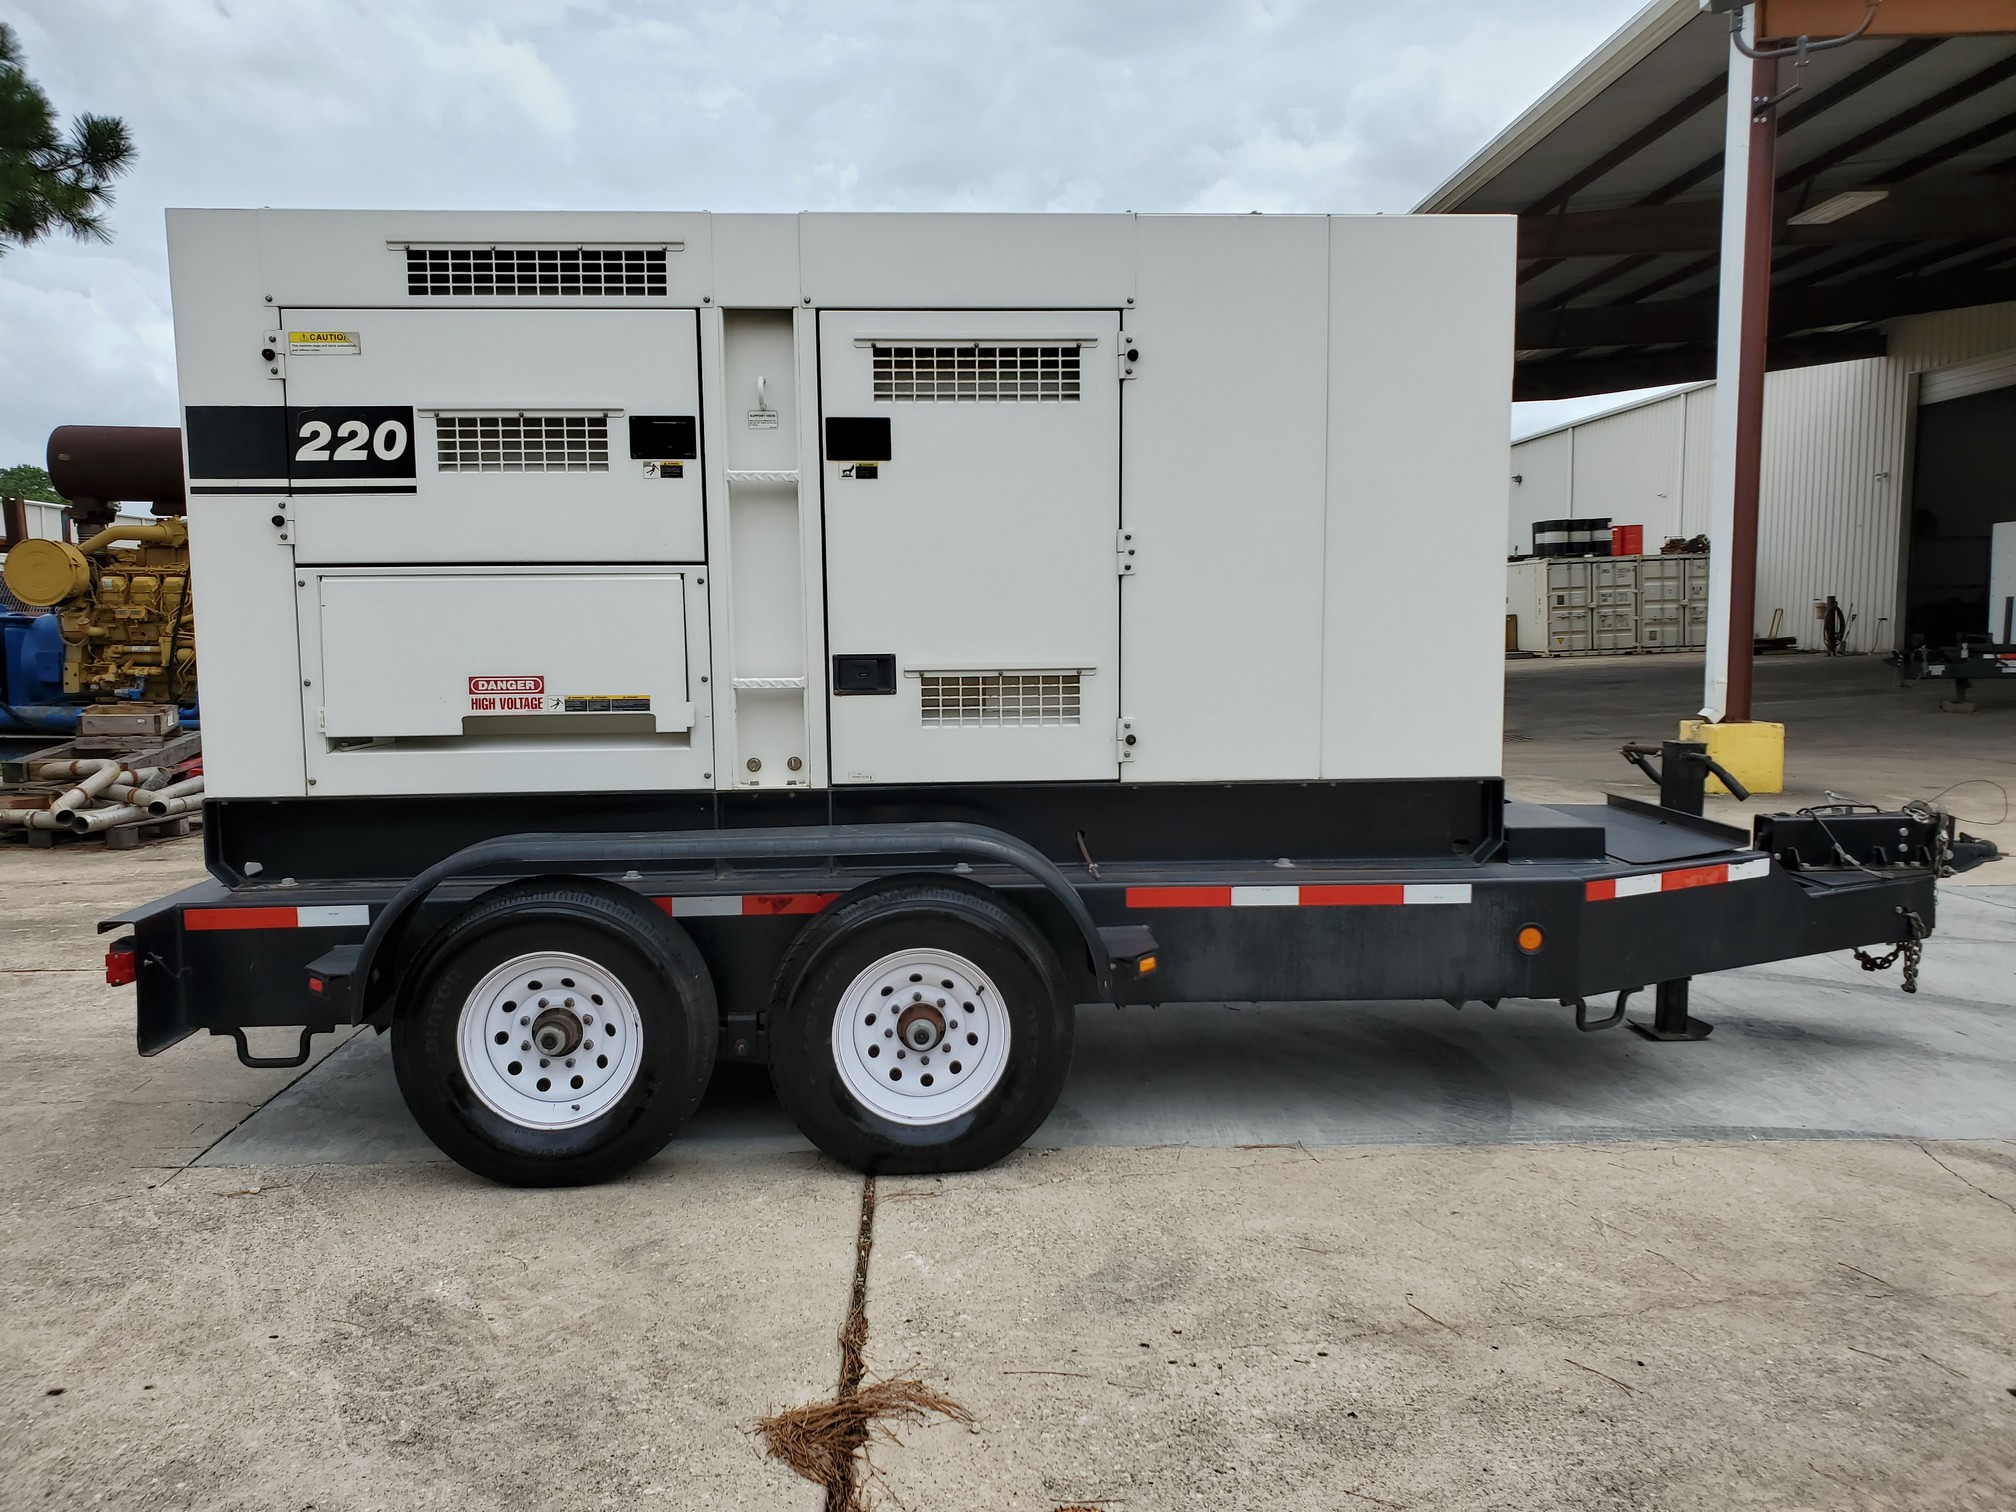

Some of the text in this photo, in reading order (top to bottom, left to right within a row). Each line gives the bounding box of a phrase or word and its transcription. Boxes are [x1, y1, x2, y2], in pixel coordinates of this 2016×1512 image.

[295, 420, 407, 461] 220
[478, 680, 535, 690] DANGER
[471, 697, 543, 710] HIGH VOLTAGE
